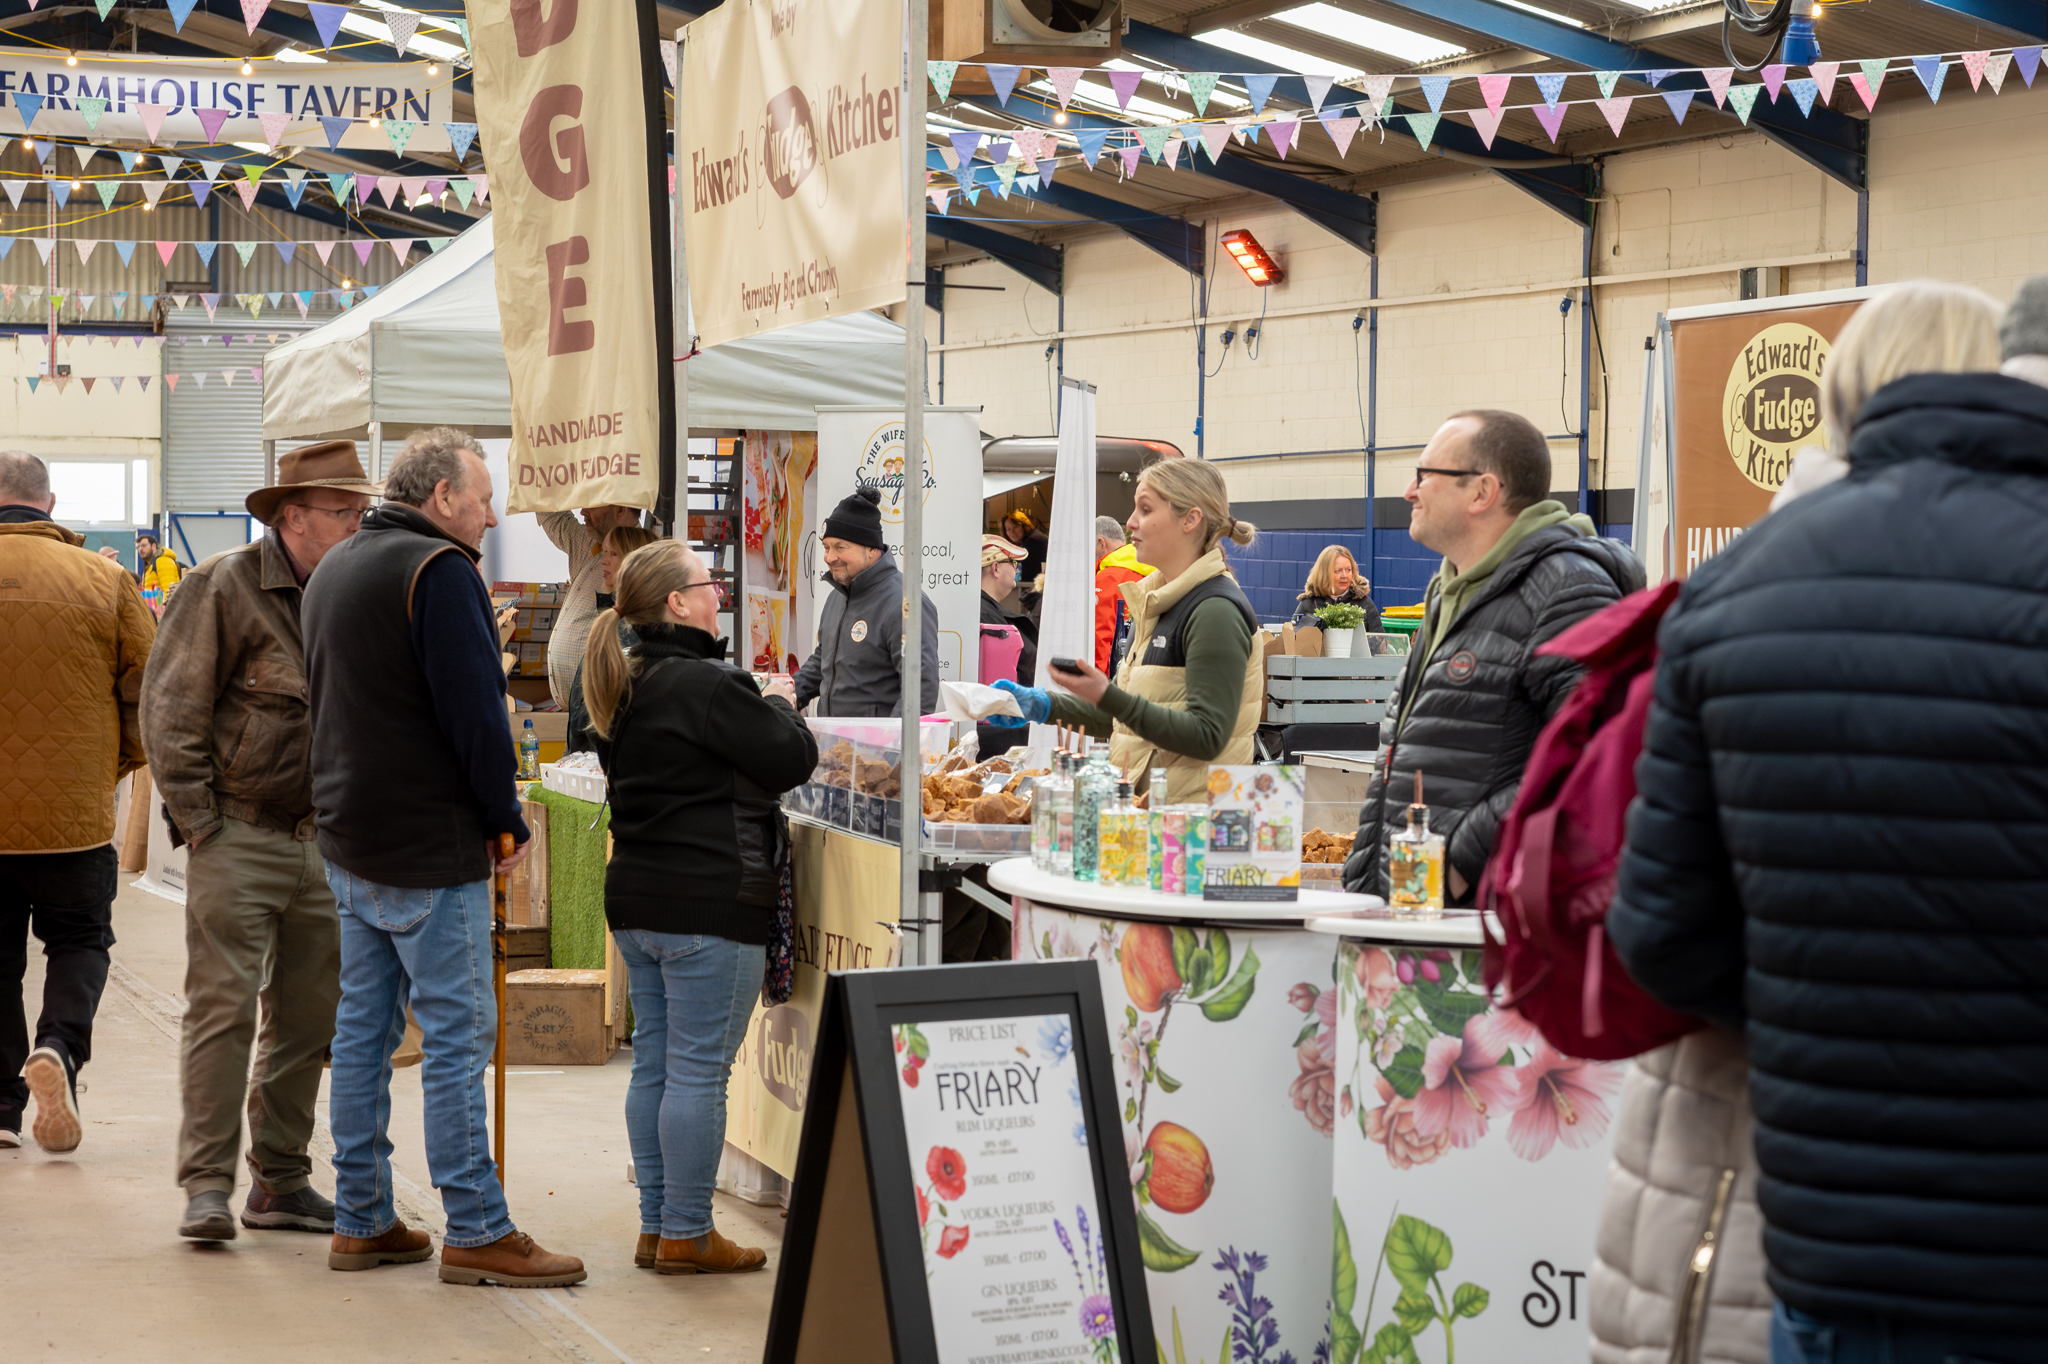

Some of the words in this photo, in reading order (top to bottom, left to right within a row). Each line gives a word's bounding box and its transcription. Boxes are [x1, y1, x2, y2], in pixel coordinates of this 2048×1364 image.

[0, 70, 265, 120] FARMHOUSE
[277, 84, 431, 127] TAVERN
[764, 106, 817, 188] Fudge
[741, 271, 781, 314] Famously
[783, 268, 795, 310] Big
[796, 261, 807, 299] and
[807, 255, 840, 299] Chunky
[1744, 334, 1826, 383] Edward's
[1753, 386, 1816, 438] Fudge
[581, 453, 641, 481] FUDGE
[866, 441, 881, 466] THE
[1745, 439, 1797, 487] Kitch
[854, 465, 905, 506] Sausag
[921, 541, 956, 561] ocal,
[928, 570, 970, 590] great
[1205, 865, 1267, 886] FRIARY
[948, 1024, 988, 1043] PRICE
[990, 1022, 1018, 1040] LIST
[935, 1061, 1042, 1117] FRIARY
[955, 1119, 981, 1134] RUM
[982, 1114, 1036, 1132] LIQUEURS
[960, 1205, 1001, 1221] VODKA
[1002, 1201, 1056, 1218] LIQUEURS
[980, 1284, 1003, 1299] GIN
[1004, 1278, 1058, 1296] LIQUEURS
